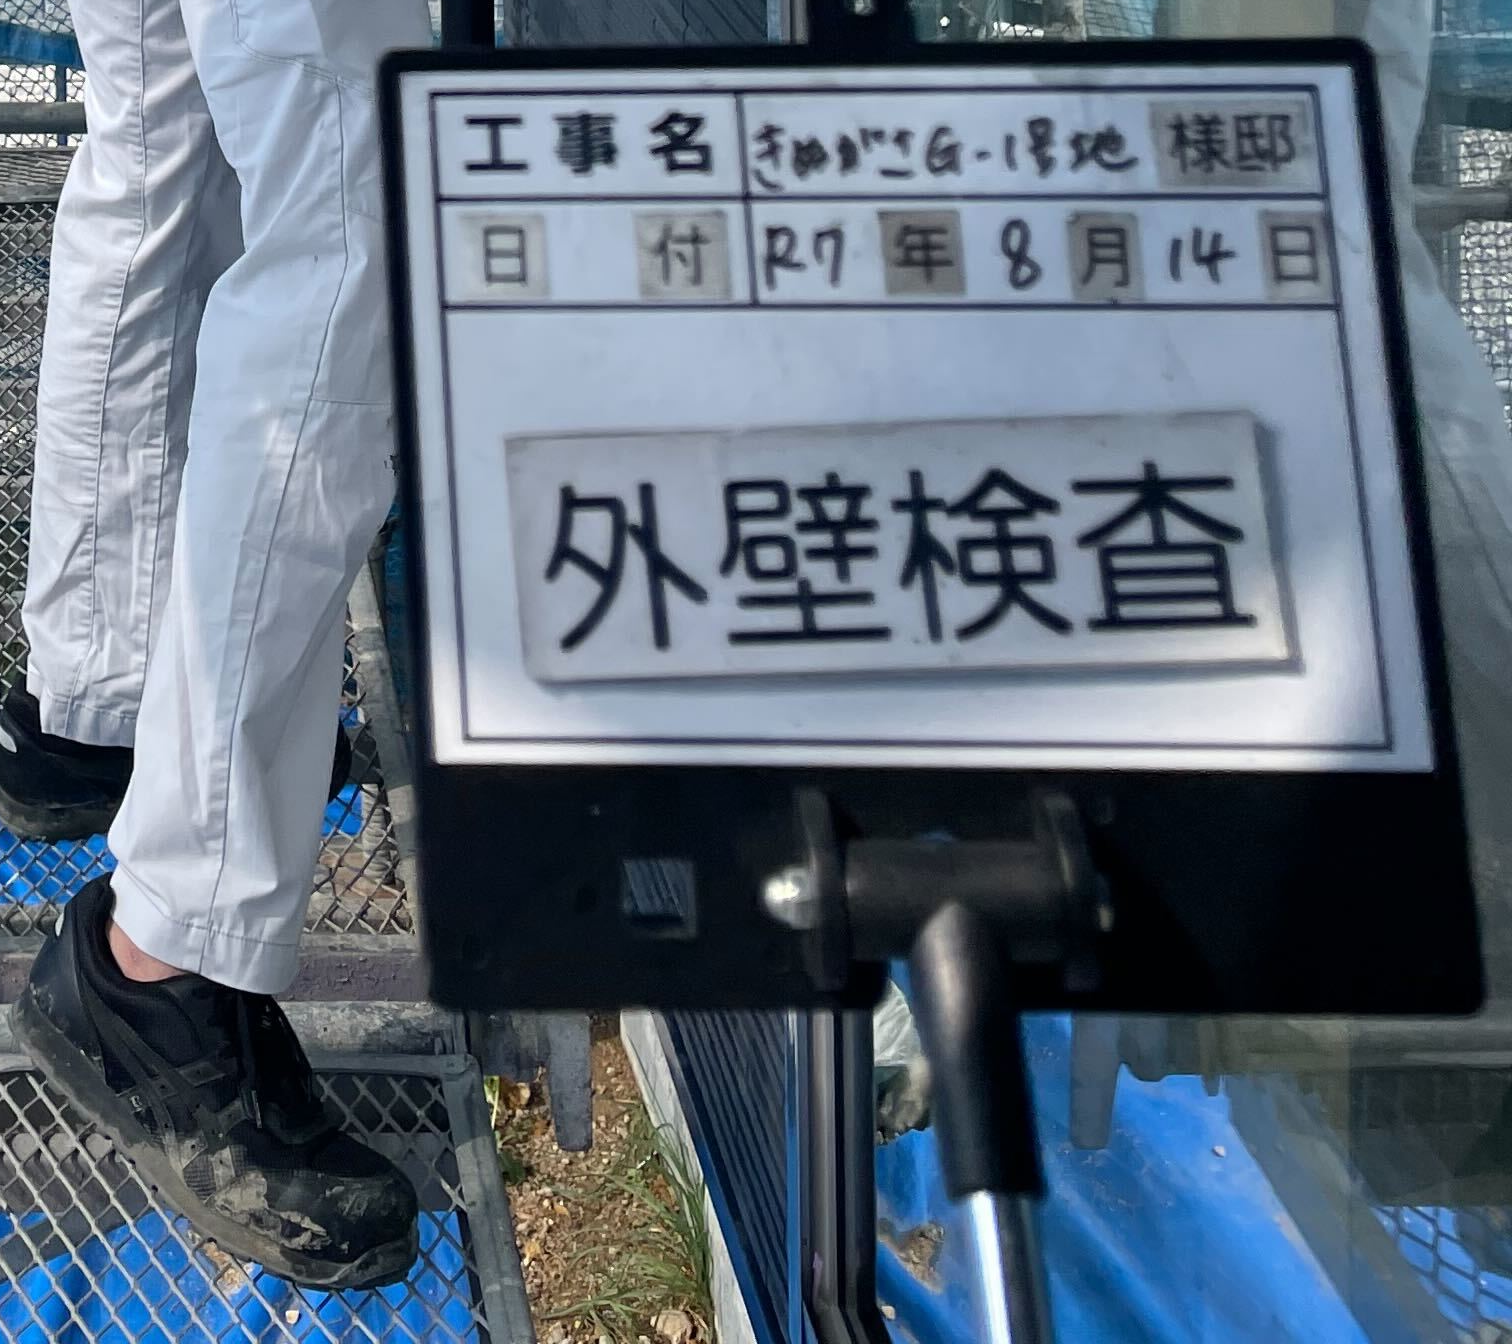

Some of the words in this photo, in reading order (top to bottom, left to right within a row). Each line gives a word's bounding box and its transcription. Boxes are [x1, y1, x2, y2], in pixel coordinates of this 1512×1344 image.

[464, 109, 714, 175] 工事名
[544, 460, 1257, 651] 外壁検査
